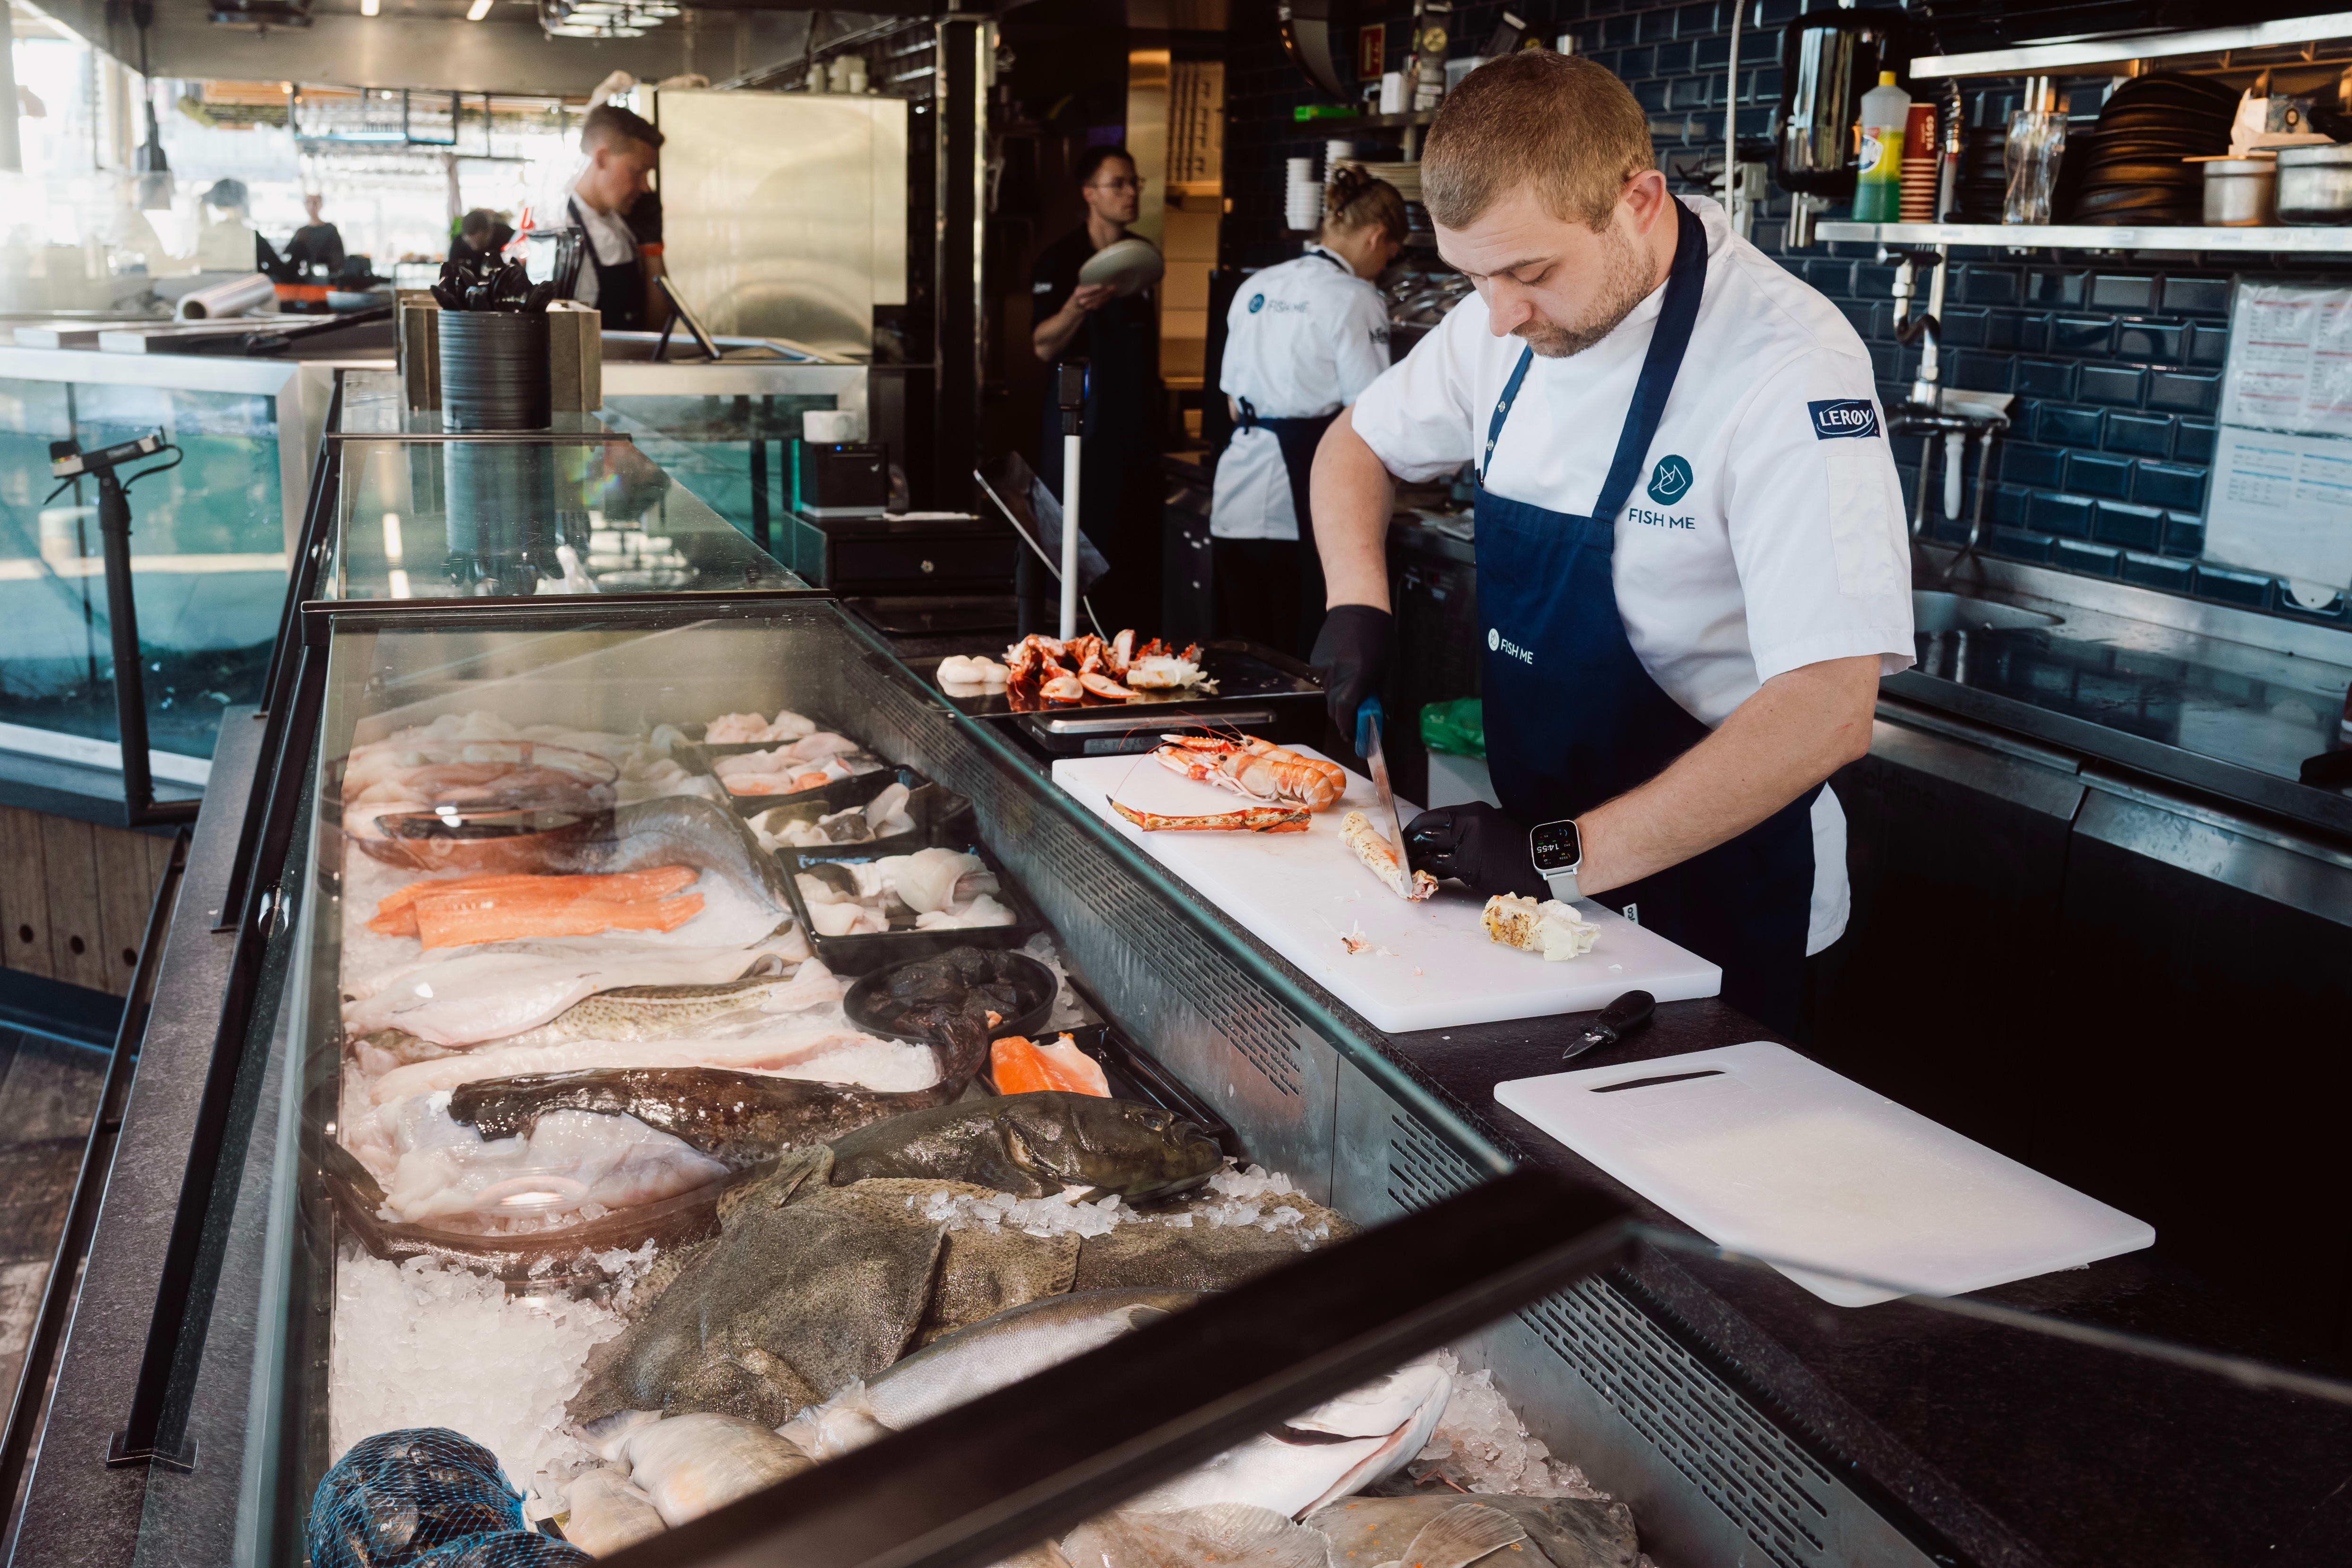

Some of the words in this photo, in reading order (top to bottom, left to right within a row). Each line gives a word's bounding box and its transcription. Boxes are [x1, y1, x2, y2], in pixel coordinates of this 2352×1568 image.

[1819, 409, 1869, 426] LERØY
[1629, 508, 1664, 527] FISH
[1669, 516, 1695, 529] ME
[1501, 638, 1519, 658] FISH
[1520, 648, 1533, 664] ME
[1537, 843, 1559, 853] 14:55
